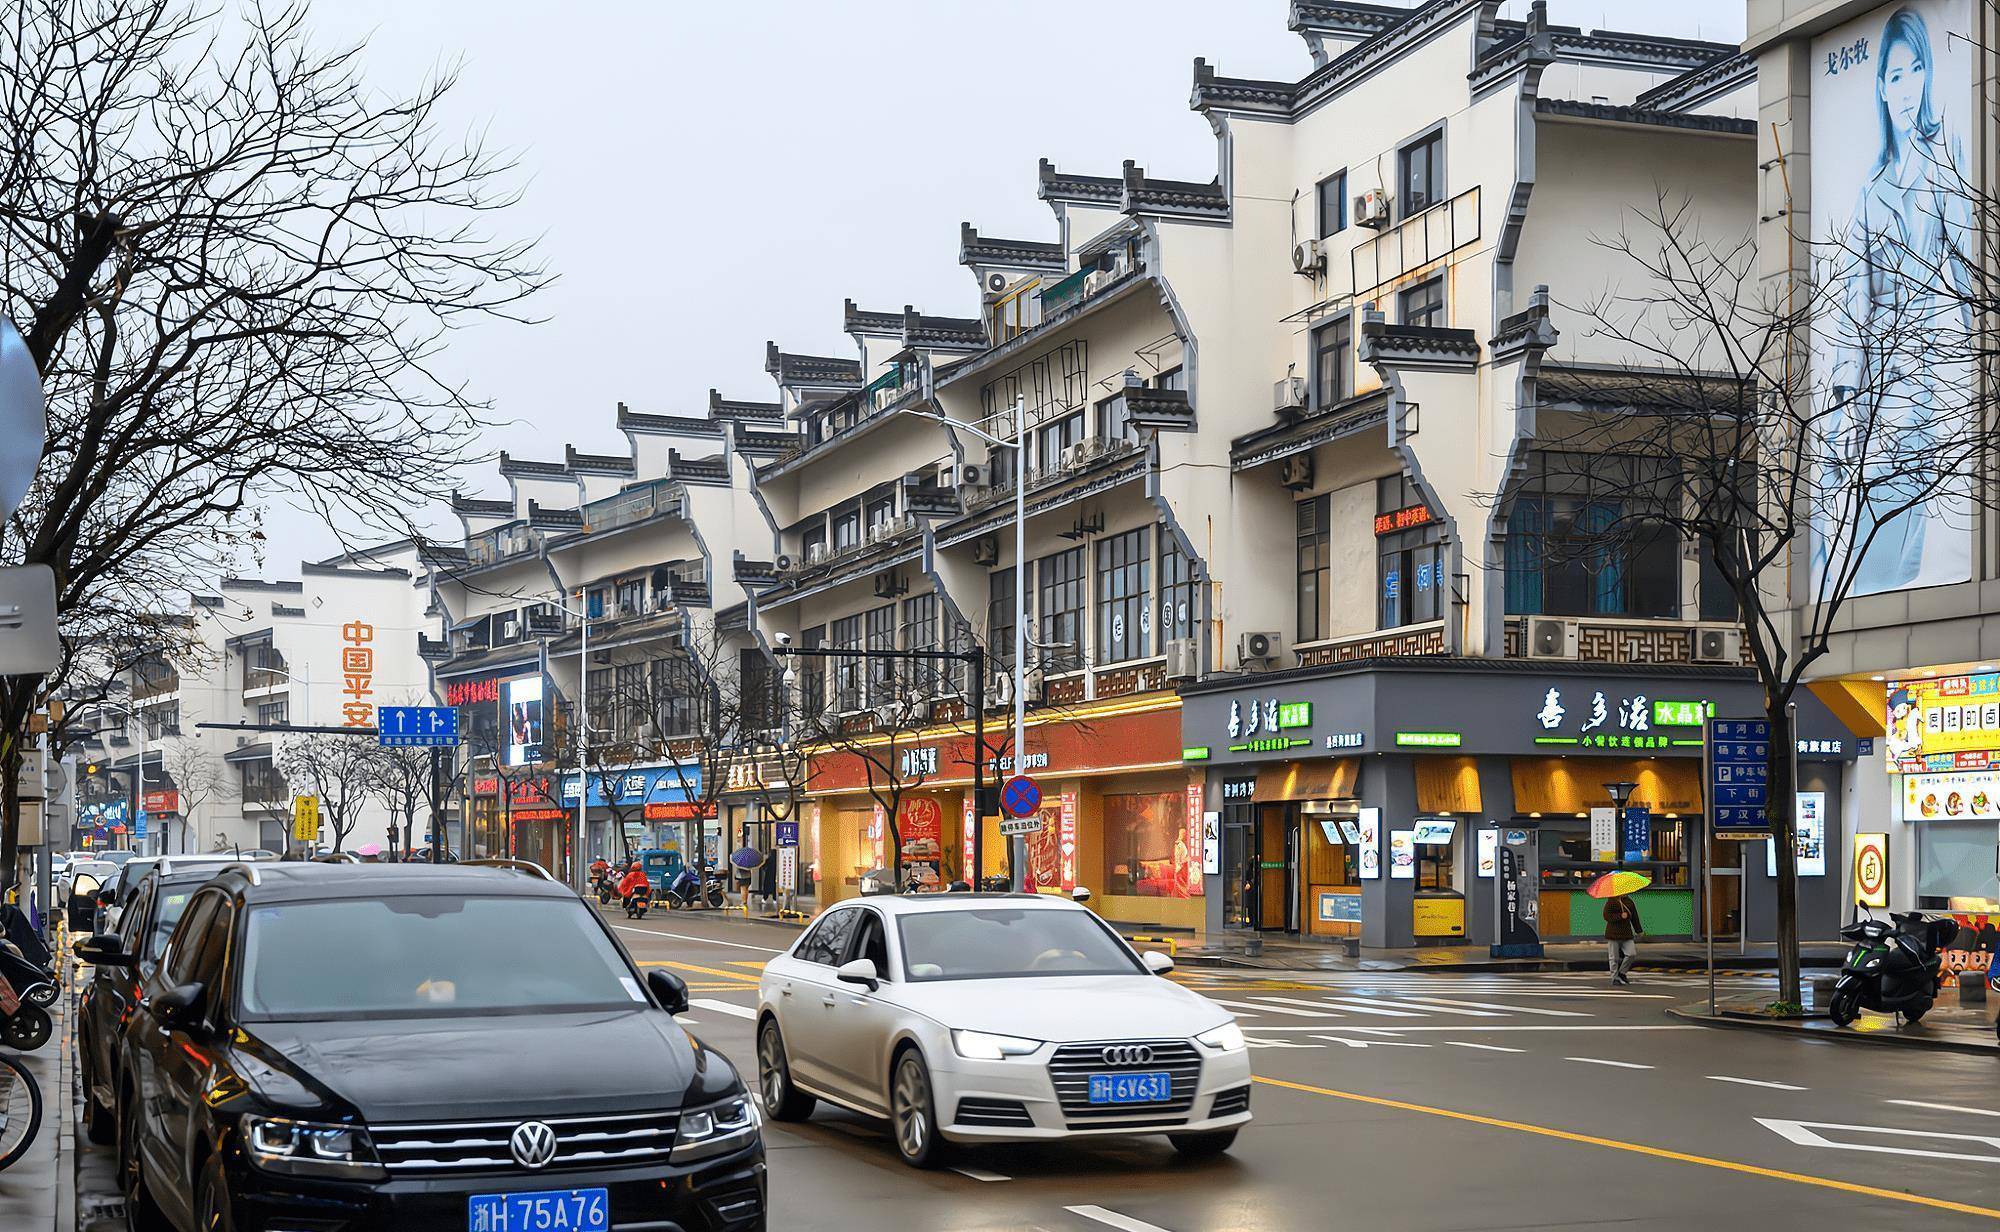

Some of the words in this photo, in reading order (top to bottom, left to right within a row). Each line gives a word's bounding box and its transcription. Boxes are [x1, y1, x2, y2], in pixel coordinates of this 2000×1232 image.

[1824, 38, 1869, 76] 戈尔牧
[343, 620, 373, 727] 中国平安
[1718, 724, 1765, 734] 新河沿
[1582, 735, 1669, 748] 小餐饮连锁品牌
[1795, 740, 1842, 754] 街旗舰店
[1736, 767, 1767, 777] 停车场
[1727, 789, 1759, 798] 下街
[1719, 809, 1767, 819] 罗汉井
